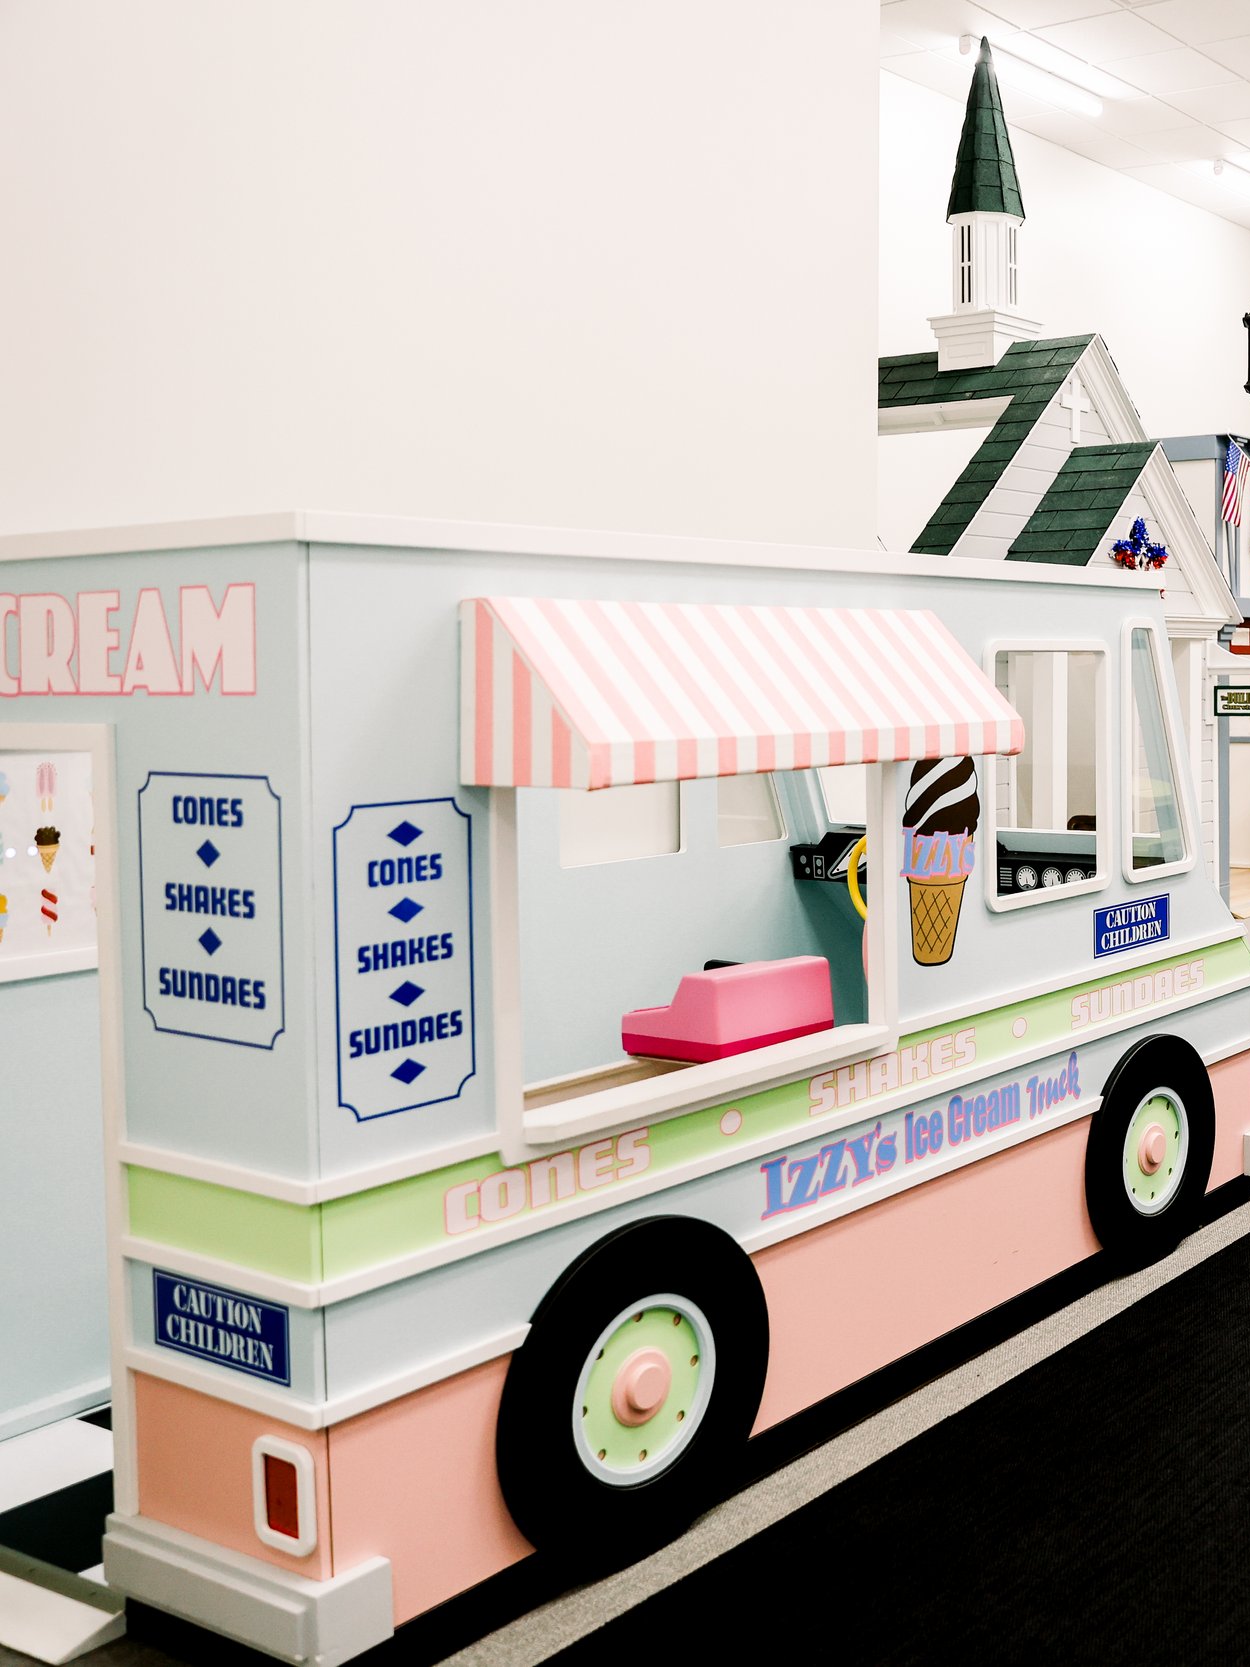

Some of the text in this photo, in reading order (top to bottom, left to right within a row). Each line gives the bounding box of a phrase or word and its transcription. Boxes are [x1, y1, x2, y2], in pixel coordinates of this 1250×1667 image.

[172, 795, 244, 828] CONES
[367, 852, 443, 888] CONES
[164, 882, 255, 919] SHAKES
[1105, 901, 1157, 929] CAUTION
[357, 932, 454, 974] SHAKES
[1100, 919, 1163, 950] CHILDREN
[159, 966, 266, 1010] SUNDAES
[349, 1009, 463, 1059] SUNDAES
[444, 958, 1206, 1235] CONES SHAKES SUNDAES
[904, 1109, 944, 1164] Ice
[947, 1081, 1021, 1147] Cream
[1025, 1051, 1082, 1120] Truck
[173, 1284, 262, 1335] CAUTION
[166, 1313, 274, 1371] CHILDREN
